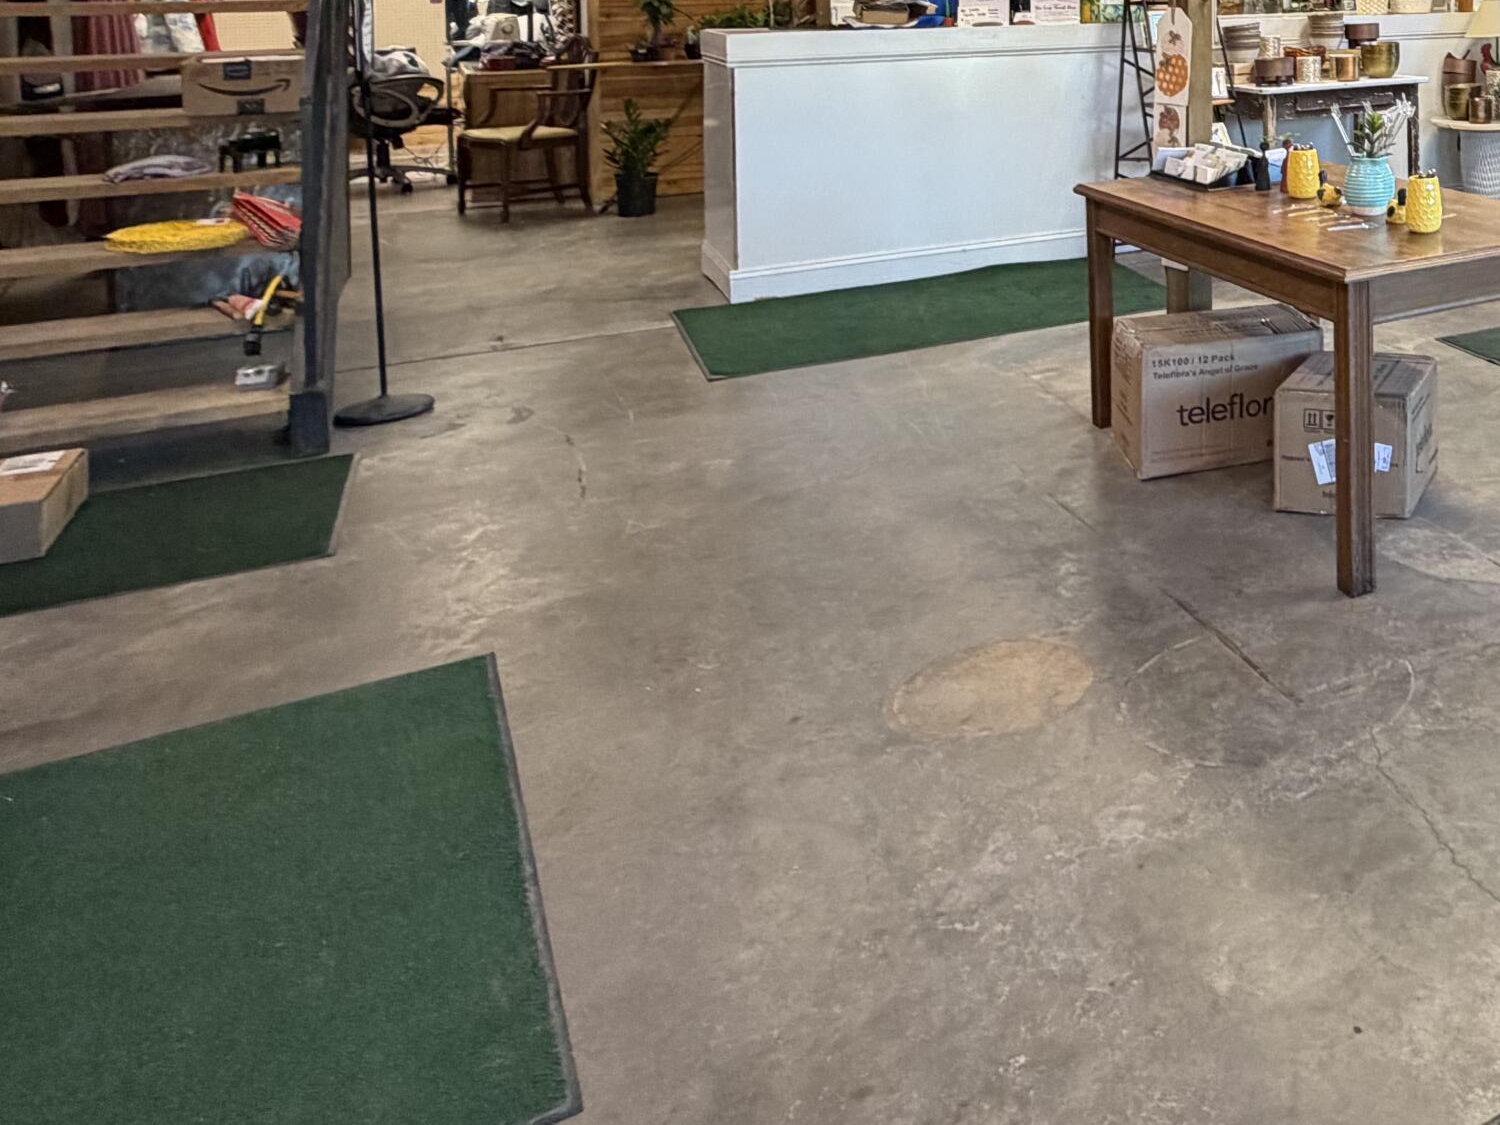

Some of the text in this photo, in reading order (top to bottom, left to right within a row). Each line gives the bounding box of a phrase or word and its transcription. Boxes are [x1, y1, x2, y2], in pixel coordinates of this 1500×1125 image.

[1198, 355, 1209, 364] 12
[1211, 353, 1235, 363] Pack
[1199, 367, 1223, 376] Angel
[1176, 393, 1274, 426] teleflor
